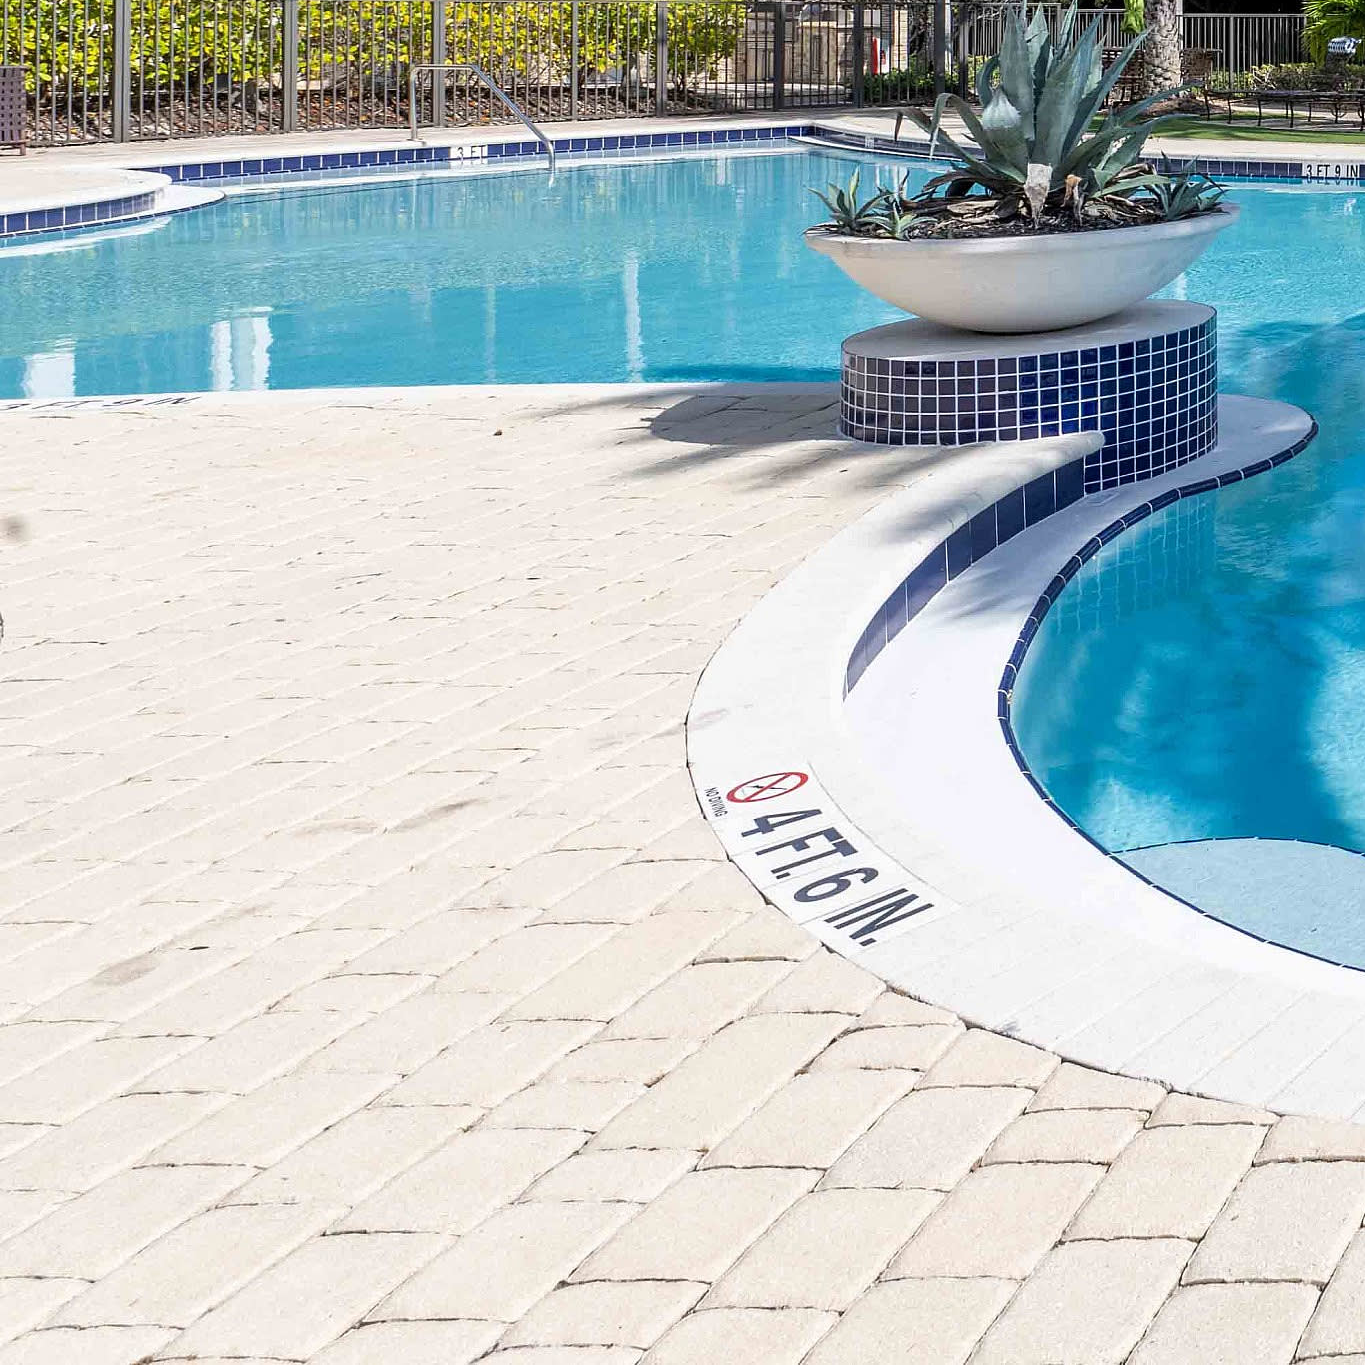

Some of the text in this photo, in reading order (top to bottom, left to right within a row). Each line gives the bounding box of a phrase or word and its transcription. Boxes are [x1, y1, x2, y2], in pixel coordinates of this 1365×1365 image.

[457, 145, 487, 158] 3 FT
[1306, 164, 1358, 177] 3 FT 9 IN
[704, 786, 728, 817] NO DIVING
[741, 809, 934, 946] 4 FT. 6 IN.
